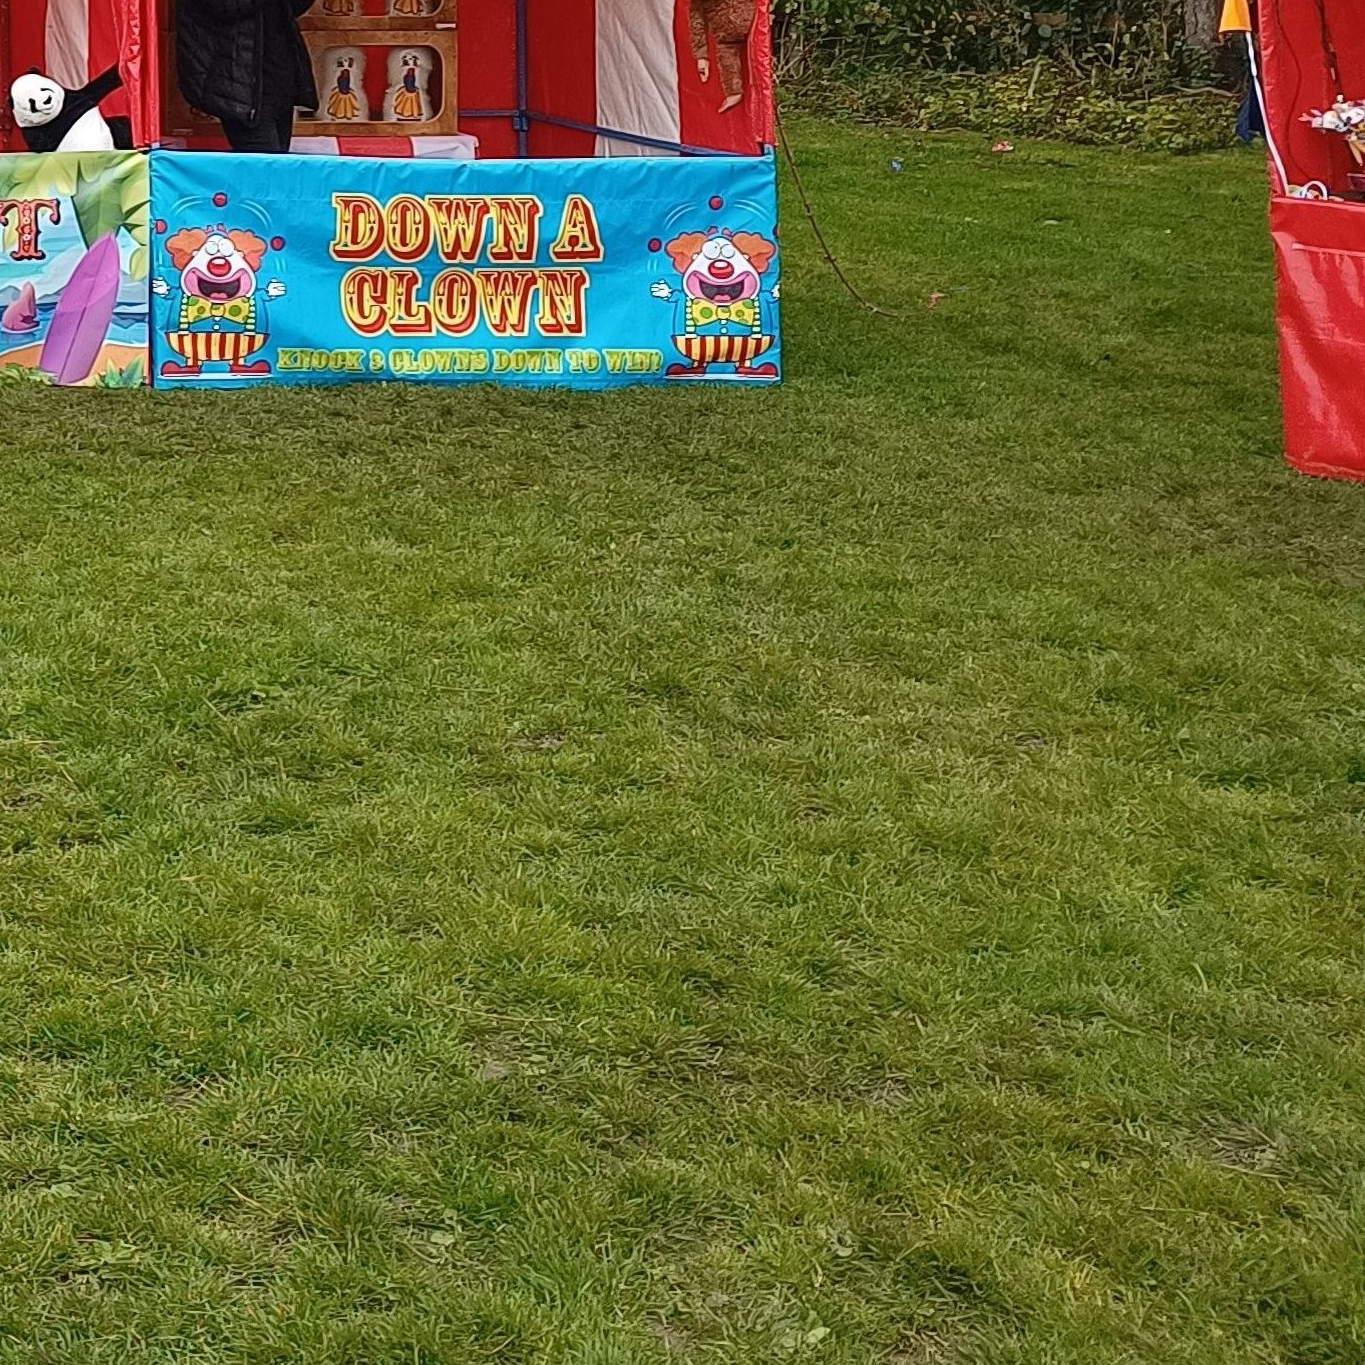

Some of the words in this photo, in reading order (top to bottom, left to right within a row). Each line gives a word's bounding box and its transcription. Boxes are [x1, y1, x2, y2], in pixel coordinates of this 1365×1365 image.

[329, 192, 542, 264] DOWN
[549, 192, 604, 264] A
[341, 266, 590, 338] CLOWN
[276, 347, 366, 373] KNOCK
[388, 348, 489, 374] CLOWNS
[491, 348, 564, 374] DOWN
[567, 349, 599, 374] TO
